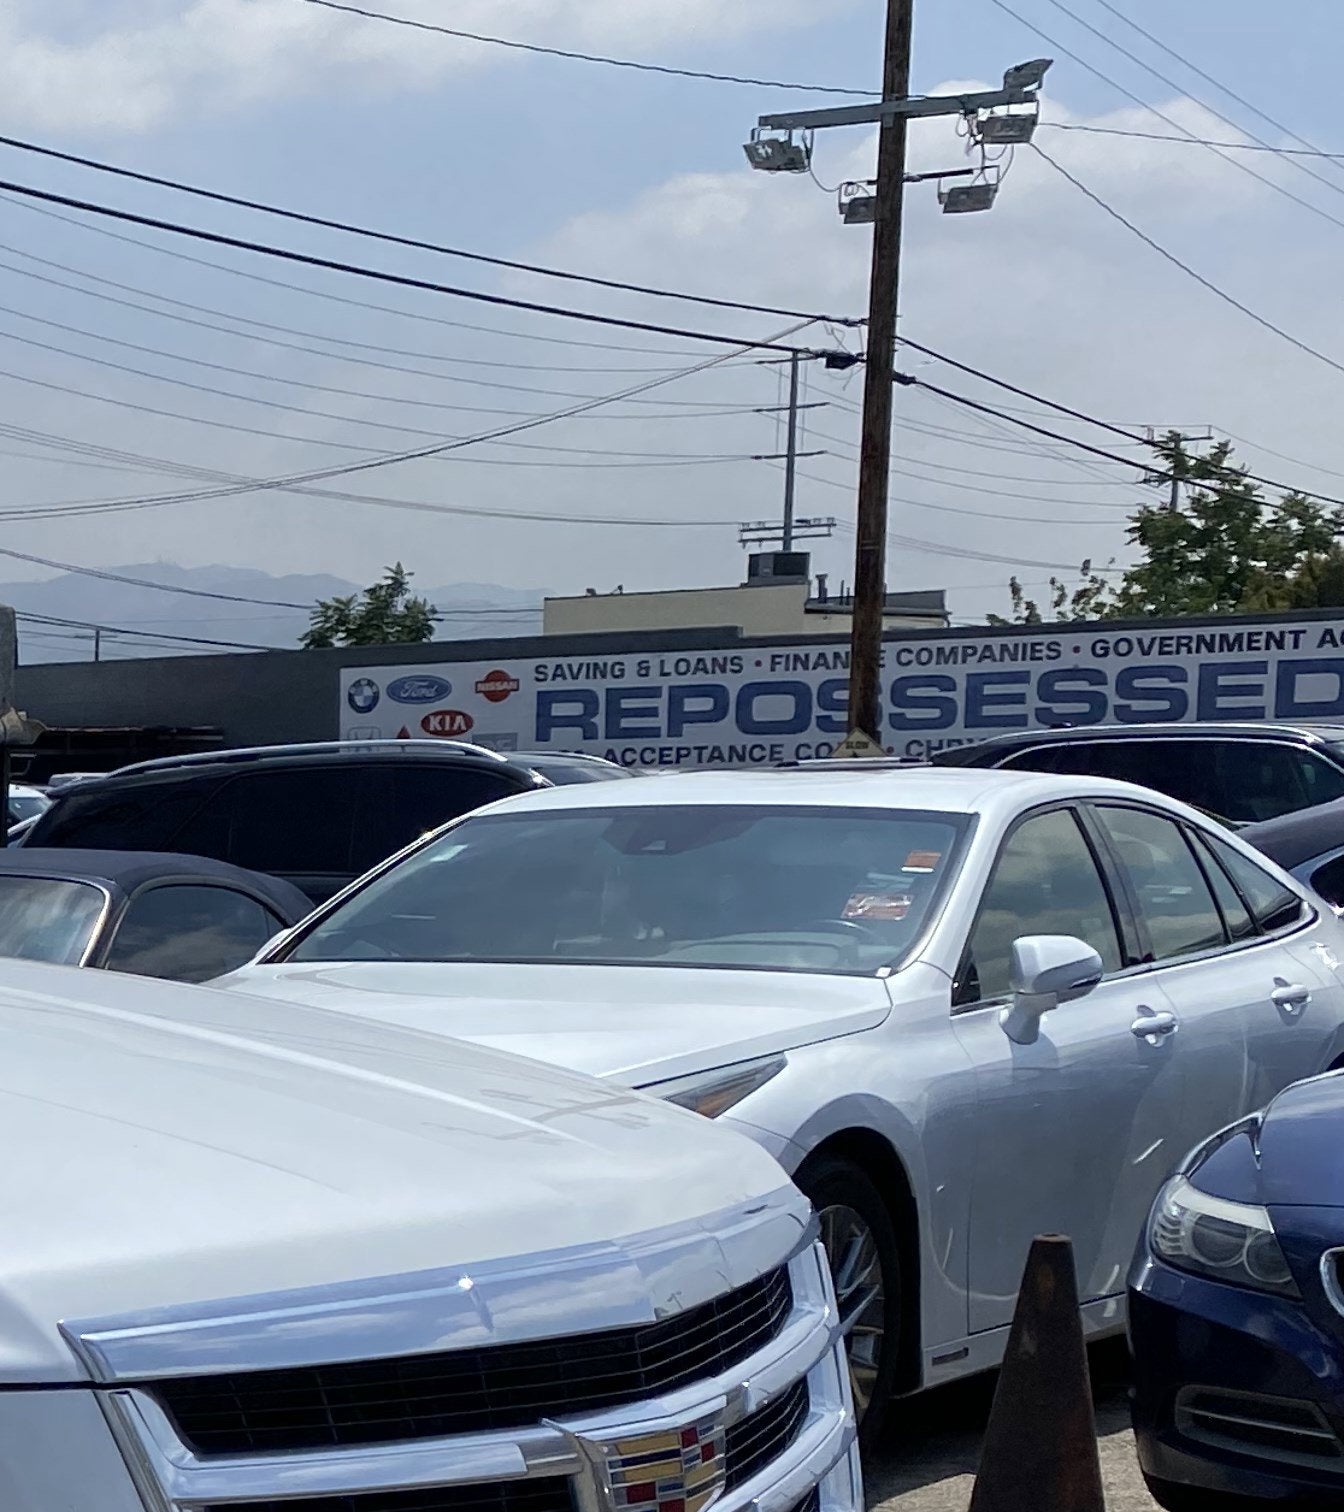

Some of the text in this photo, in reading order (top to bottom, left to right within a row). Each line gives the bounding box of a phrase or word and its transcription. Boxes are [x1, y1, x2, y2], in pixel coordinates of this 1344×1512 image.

[534, 661, 625, 682] SAVING
[637, 659, 651, 678] &
[659, 655, 744, 678] LOANS
[770, 648, 886, 673] FINANE
[895, 641, 1062, 668] COMPANIES
[1090, 629, 1308, 659] GOVERNMENT
[398, 681, 440, 699] Ford
[428, 714, 467, 732] KIA
[604, 743, 785, 767] ACCEPTANCE
